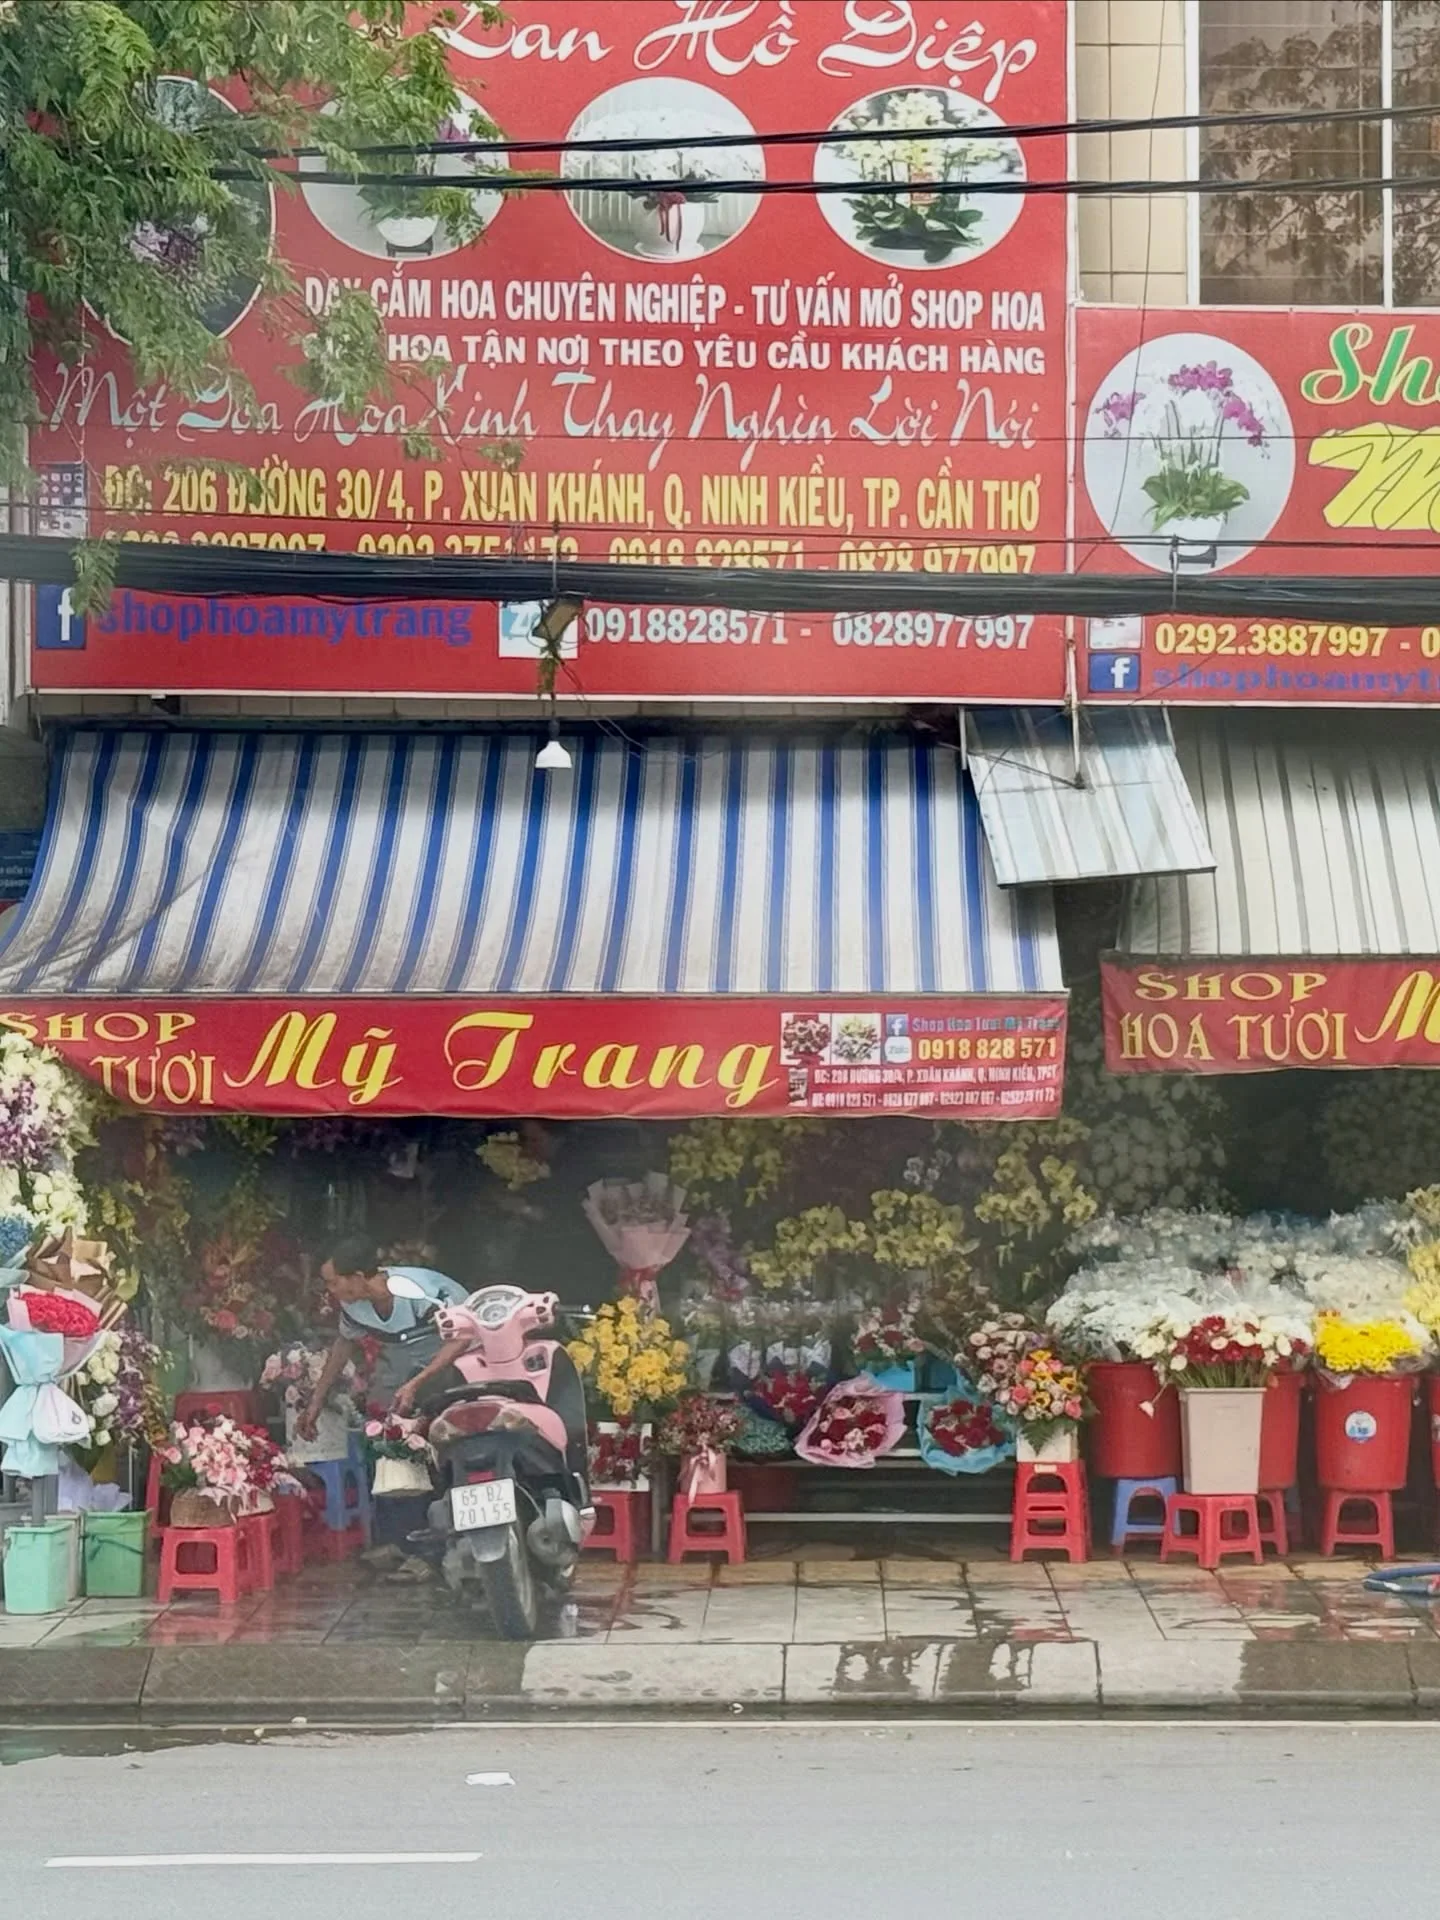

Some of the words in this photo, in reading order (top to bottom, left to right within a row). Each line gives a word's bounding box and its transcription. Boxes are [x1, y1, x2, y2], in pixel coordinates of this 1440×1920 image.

[370, 262, 432, 318] CẮM
[441, 279, 497, 320] HOA
[505, 271, 616, 323] CHUYÊN
[625, 273, 726, 332] NGHIỆP
[734, 305, 744, 314] -
[752, 279, 790, 326] TƯ
[796, 271, 850, 328] VẤN
[860, 272, 904, 329] MỞ
[911, 289, 983, 330] SHOP
[991, 291, 1045, 332] HOA
[388, 334, 452, 362] HOA
[462, 329, 526, 369] TẬN
[537, 333, 589, 365] NƠI
[599, 338, 684, 367] THEO
[694, 333, 757, 368] YÊU
[767, 330, 831, 370] CẦU
[842, 337, 949, 373] KHÁCH
[960, 339, 1045, 375] HÀNG
[1301, 322, 1440, 406] Sh
[49, 362, 169, 448] Một
[551, 366, 675, 472] Thay
[688, 373, 838, 473] Nghìn
[848, 374, 940, 447] Lời
[949, 377, 1041, 449] Nói
[162, 464, 217, 516] 206
[336, 468, 414, 530] 30/4,
[424, 469, 450, 521] P.
[460, 458, 537, 522] XUÂN
[547, 458, 655, 535] KHÁNH,
[663, 473, 691, 531] Q.
[702, 474, 768, 526] NINH
[778, 454, 854, 535] KIỀU,
[863, 477, 908, 528] TP.
[916, 456, 974, 530] CẦN
[982, 473, 1042, 531] THƠ
[100, 591, 472, 647] shophoamytrang
[585, 607, 788, 645] 0918828571
[832, 610, 1035, 649] 0828977997
[1155, 622, 1389, 657] 0292.3887997
[1153, 662, 1440, 697] shophoamyt
[1134, 972, 1327, 1004] SHOP
[0, 1011, 197, 1045] SHOP
[912, 1017, 945, 1032] Shop
[1119, 1011, 1215, 1061] HOA
[1226, 1005, 1349, 1061] TƯƠI
[222, 1010, 404, 1106] Mỹ
[443, 1010, 780, 1109] Trang
[918, 1037, 971, 1061] 0918
[976, 1036, 1016, 1060] 828
[1020, 1036, 1057, 1059] 571
[89, 1047, 216, 1106] TƯƠI
[462, 1488, 478, 1506] 65
